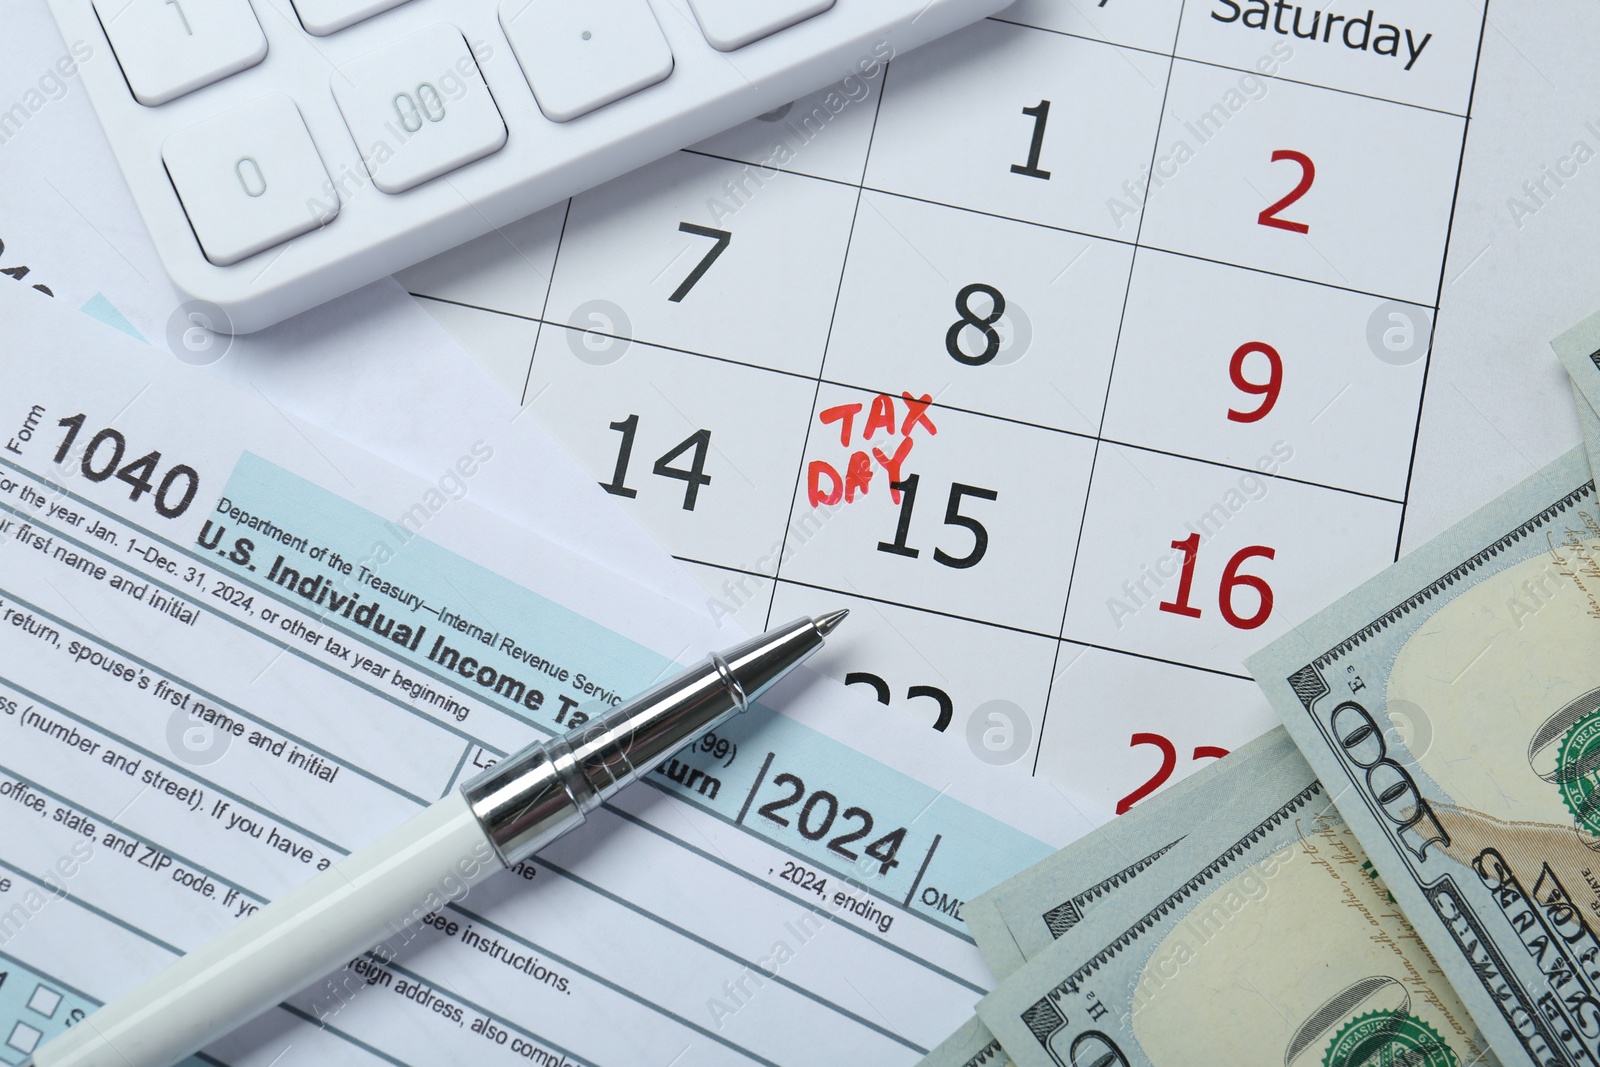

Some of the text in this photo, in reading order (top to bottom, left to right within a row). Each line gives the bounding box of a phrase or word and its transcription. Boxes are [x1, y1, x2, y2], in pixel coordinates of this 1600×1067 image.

[392, 81, 447, 133] 00
[1010, 99, 1051, 181] 1
[234, 155, 267, 198] 0
[1257, 149, 1316, 235] 2
[668, 221, 732, 303] 7
[945, 283, 1006, 366] 8
[3, 404, 46, 456] Form
[819, 391, 937, 448] TAX
[1227, 341, 1283, 423] 9
[52, 412, 200, 520] 1040
[598, 414, 712, 512] 14
[807, 436, 914, 508] DAY
[876, 473, 998, 570] 15
[15, 522, 53, 555] first
[52, 545, 107, 581] name
[108, 574, 149, 601] and
[147, 588, 201, 627] initial
[18, 484, 46, 509] the
[45, 501, 86, 527] year
[84, 520, 118, 547] Jan.
[182, 566, 206, 593] 31,
[210, 580, 255, 616] 2024,
[259, 607, 280, 624] or
[279, 617, 324, 646] other
[323, 636, 351, 661] tax
[349, 652, 391, 679] year
[389, 668, 471, 722] beginning
[215, 496, 309, 554] Department
[308, 546, 330, 563] of
[327, 554, 353, 577] the
[497, 636, 569, 683] Revenue
[572, 673, 621, 707] Servic
[1159, 533, 1275, 630] 16
[195, 518, 257, 573] U.S.
[265, 554, 427, 652] Individual
[426, 634, 545, 711] Income
[553, 693, 589, 731] Ta
[2, 607, 61, 650] return,
[152, 679, 191, 711] first
[190, 701, 245, 737] name
[247, 730, 288, 758] and
[286, 745, 340, 784] initial
[756, 772, 908, 876] 2024
[1320, 694, 1453, 866] 100
[19, 704, 101, 756] (number
[100, 749, 142, 777] and
[140, 768, 204, 812] street).
[210, 798, 231, 820] If
[224, 811, 264, 839] you
[265, 826, 314, 864] have
[315, 857, 331, 872] a
[421, 911, 459, 937] see
[459, 921, 571, 996] instructions.
[778, 860, 894, 933] 2024, ending
[1310, 857, 1340, 880] and
[1329, 839, 1358, 864] that
[0, 780, 47, 818] office,
[53, 805, 98, 842] state,
[101, 830, 142, 859] and
[138, 846, 173, 872] ZIP
[172, 868, 217, 900] code.
[221, 886, 242, 908] If
[347, 957, 393, 988] reign
[394, 980, 464, 1027] address,
[469, 1016, 508, 1045] also
[1468, 842, 1600, 1041] STATES
[1432, 887, 1556, 1065] DOLLARS
